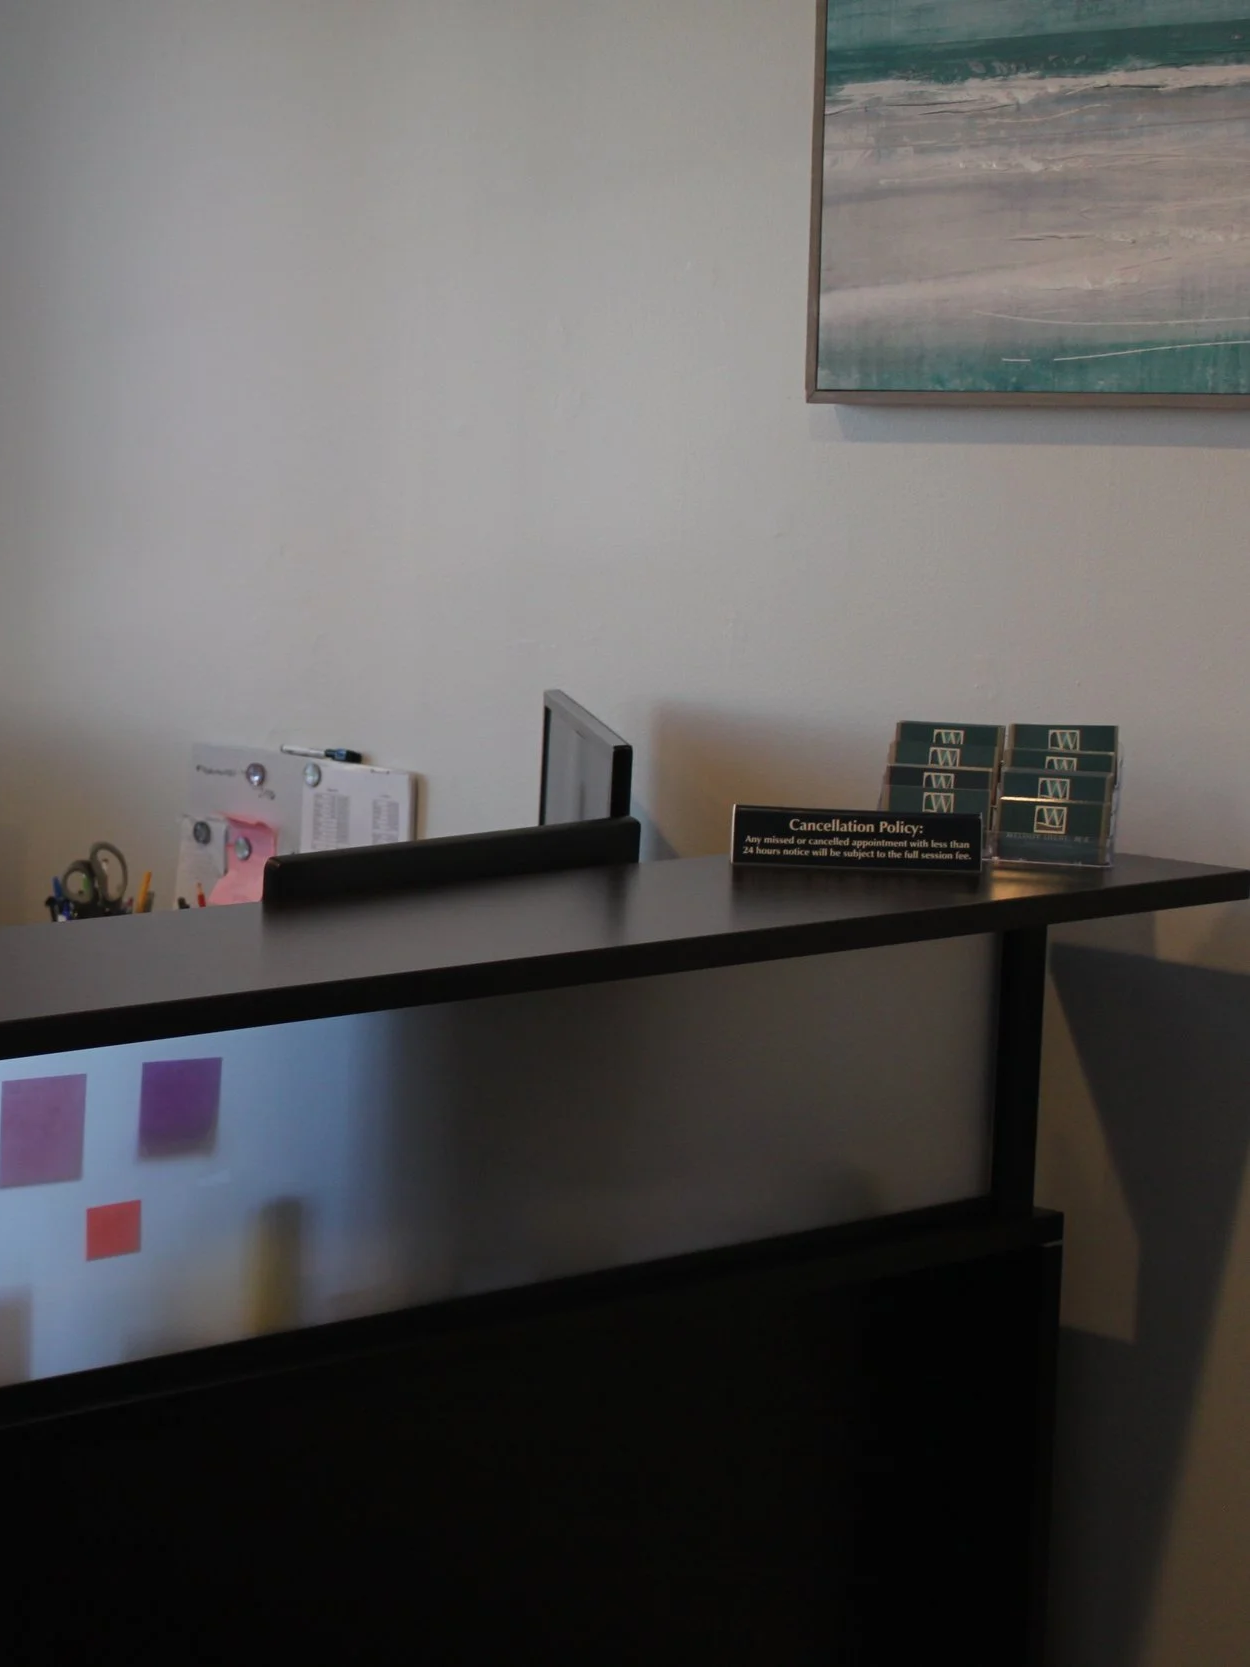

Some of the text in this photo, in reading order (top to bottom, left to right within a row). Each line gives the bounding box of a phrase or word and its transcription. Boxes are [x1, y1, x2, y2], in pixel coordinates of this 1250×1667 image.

[788, 818, 924, 838] Cancellation Policy:
[744, 835, 761, 844] Any
[763, 836, 795, 845] missed
[808, 837, 850, 847] cancelled
[851, 838, 908, 849] appointment
[909, 839, 929, 849] with
[931, 839, 948, 849] less
[950, 840, 970, 849] than
[742, 846, 972, 861] 24 hours notice will be subject to the full session fee.
